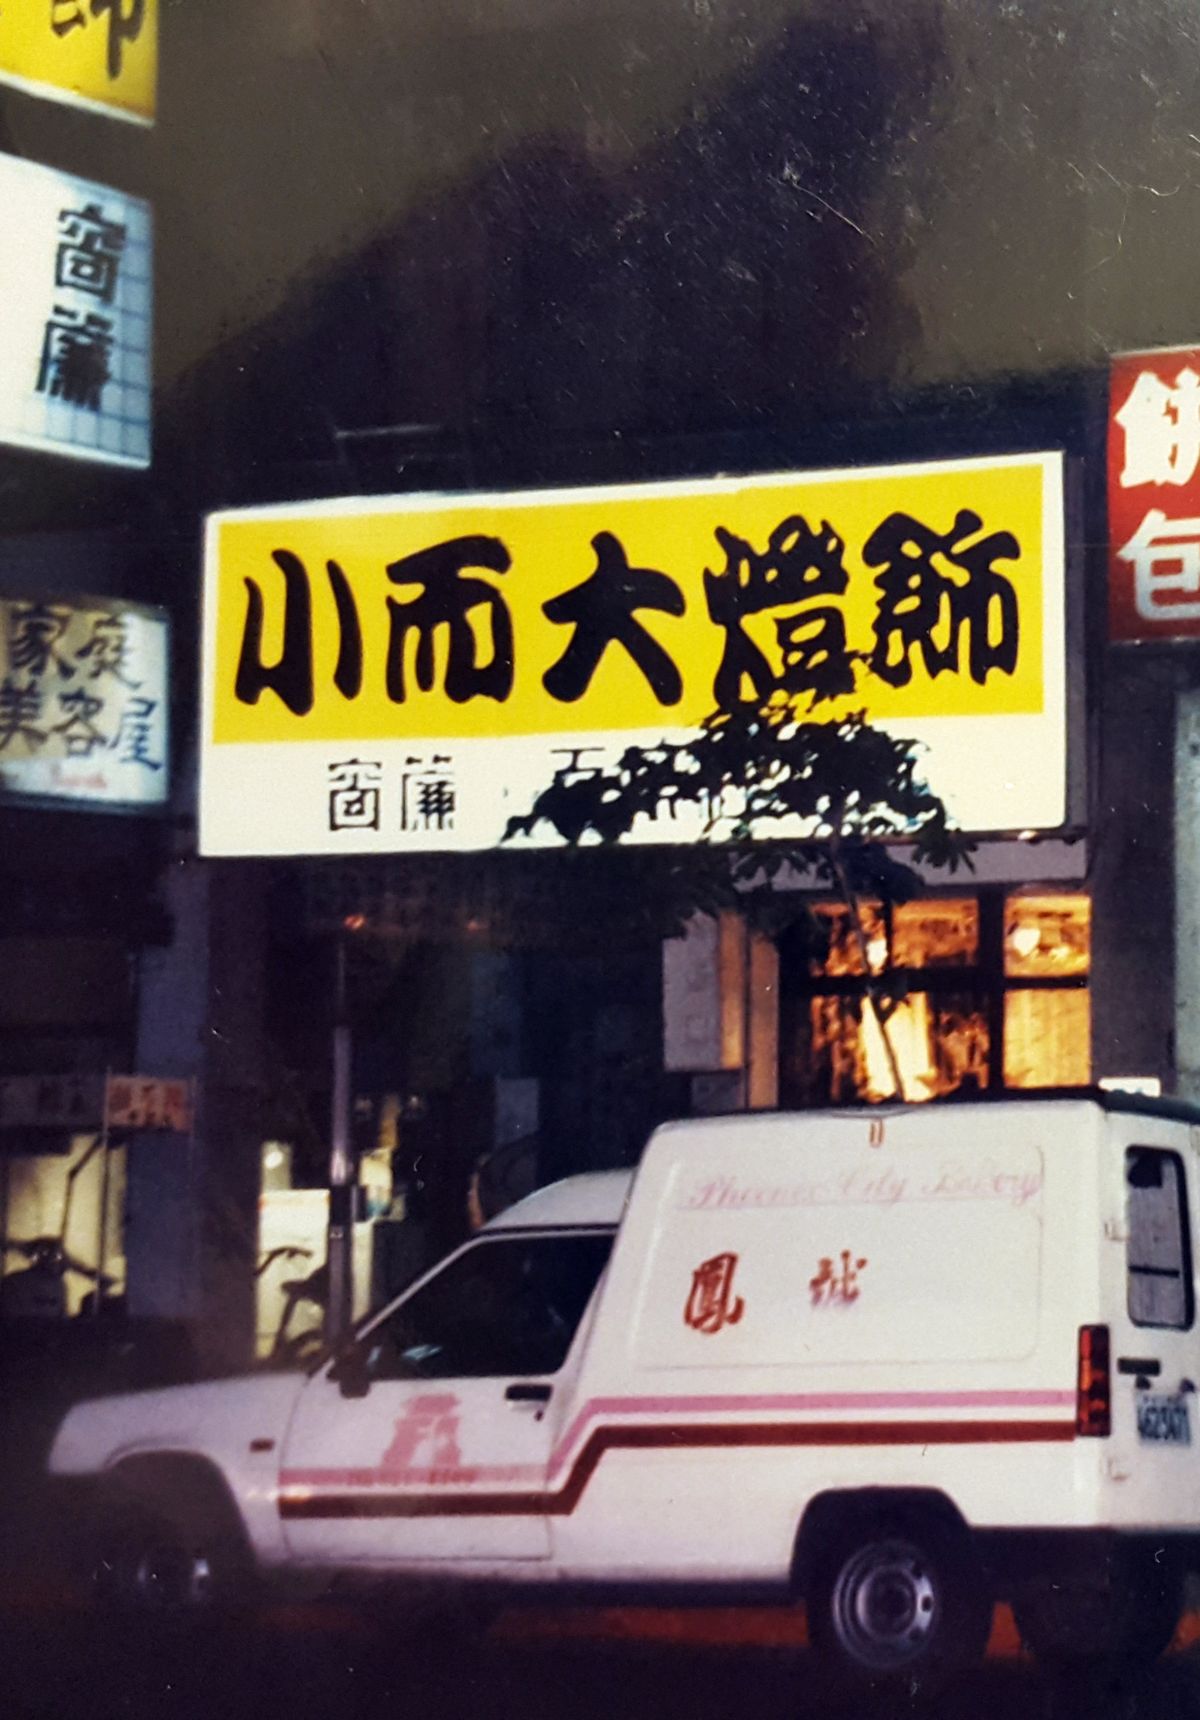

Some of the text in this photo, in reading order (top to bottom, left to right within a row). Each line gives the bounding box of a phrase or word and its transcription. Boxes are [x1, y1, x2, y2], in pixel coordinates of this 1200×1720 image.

[233, 508, 1022, 717] 小而大燈飾
